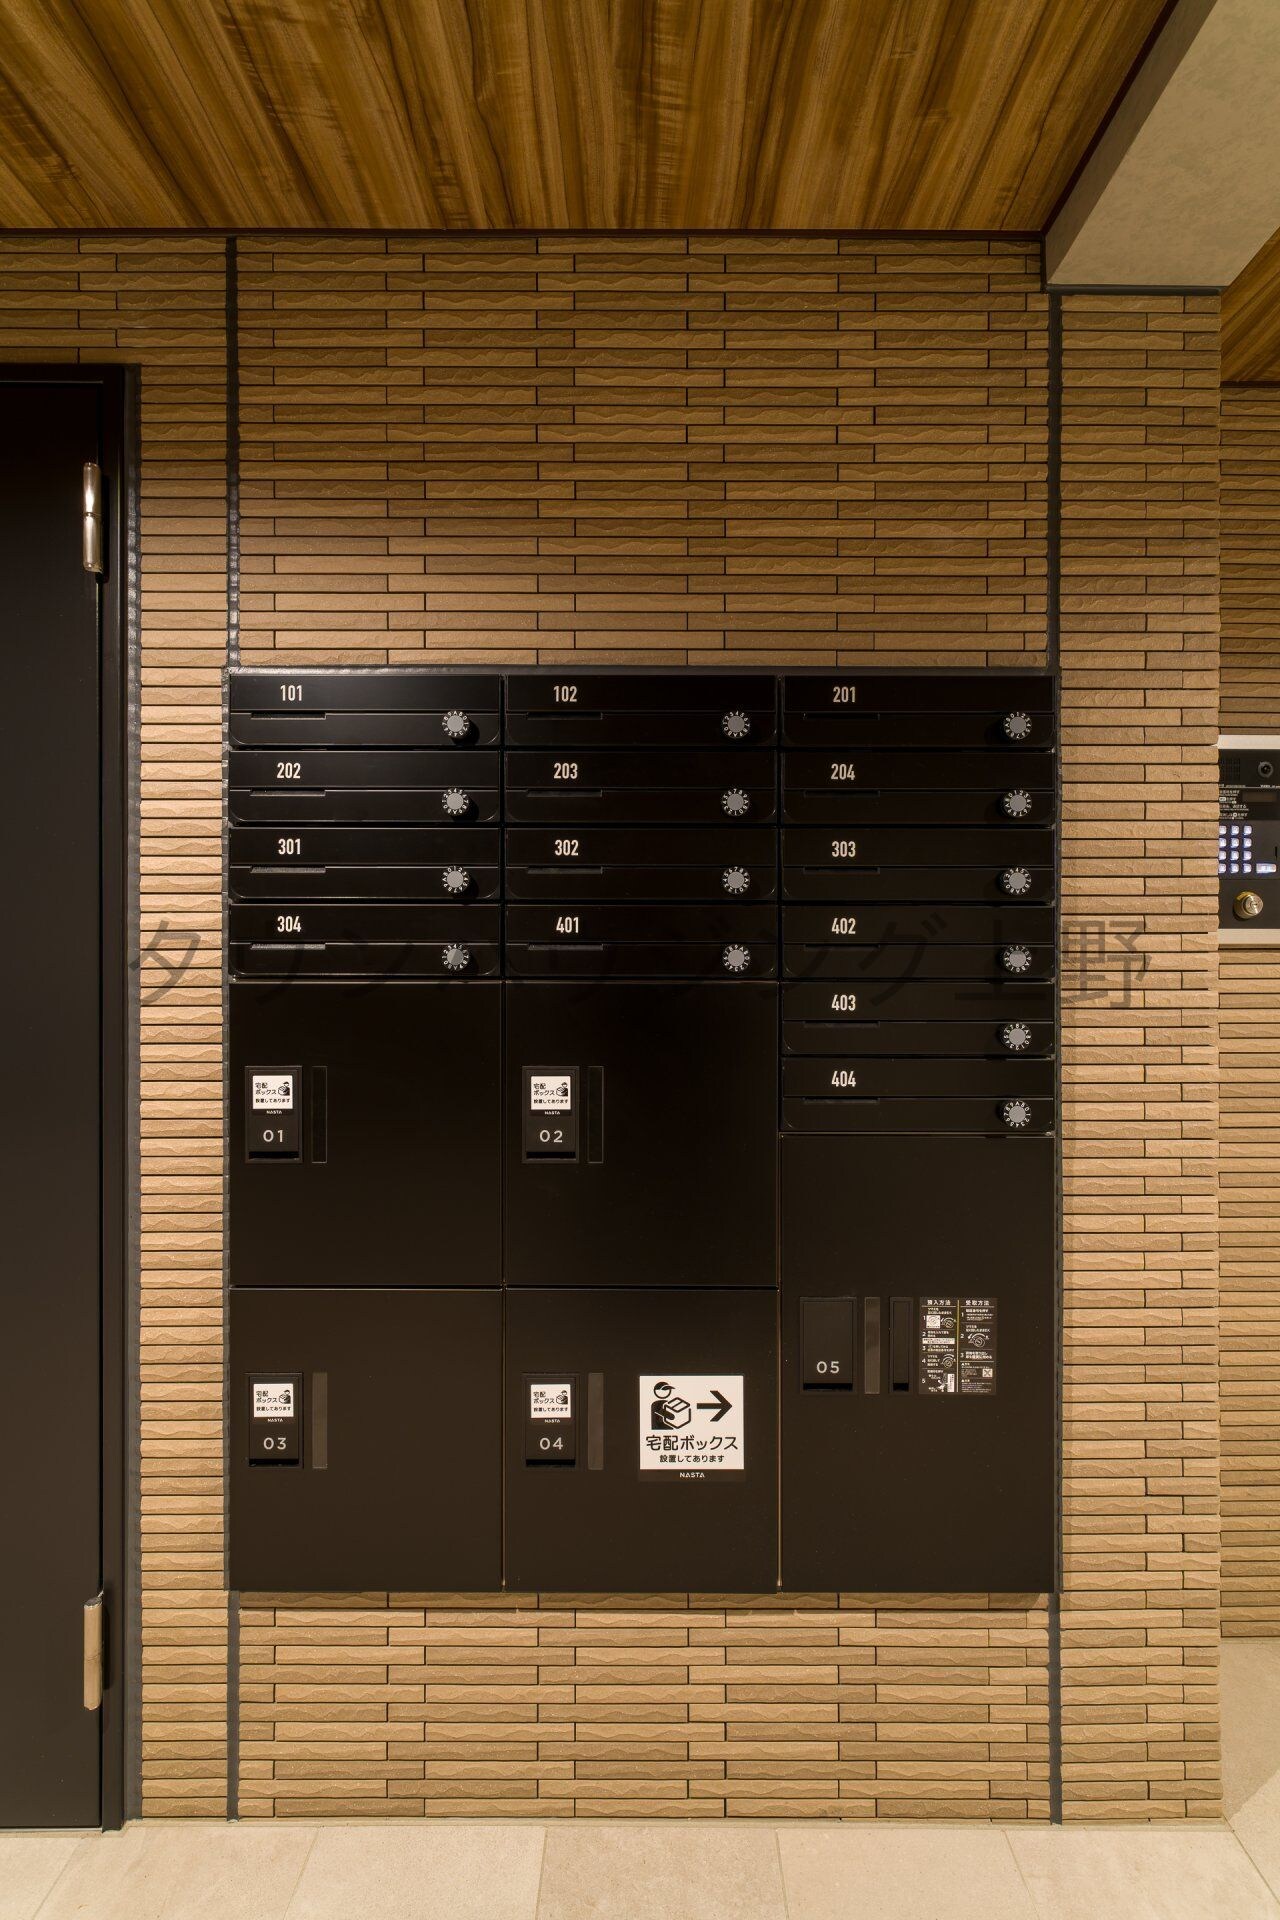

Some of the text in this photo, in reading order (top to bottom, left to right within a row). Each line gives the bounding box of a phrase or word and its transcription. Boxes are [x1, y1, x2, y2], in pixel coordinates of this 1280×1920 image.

[280, 685, 304, 702] 101
[554, 686, 577, 703] 102
[832, 686, 855, 703] 201
[277, 762, 301, 779] 202
[553, 763, 578, 779] 203
[831, 764, 855, 780] 204
[278, 839, 301, 856] 301
[554, 840, 579, 857] 302
[831, 841, 856, 857] 303
[276, 916, 301, 933] 304
[555, 917, 579, 934] 401
[831, 918, 856, 934] 402
[831, 995, 856, 1012] 403
[831, 1071, 856, 1088] 404
[263, 1129, 283, 1143] 01
[539, 1129, 563, 1143] 02
[816, 1360, 840, 1374] 05
[263, 1437, 287, 1450] 03
[539, 1437, 564, 1450] 04
[645, 1434, 738, 1451] 宅配ボックス
[660, 1454, 725, 1463] 設置してあります
